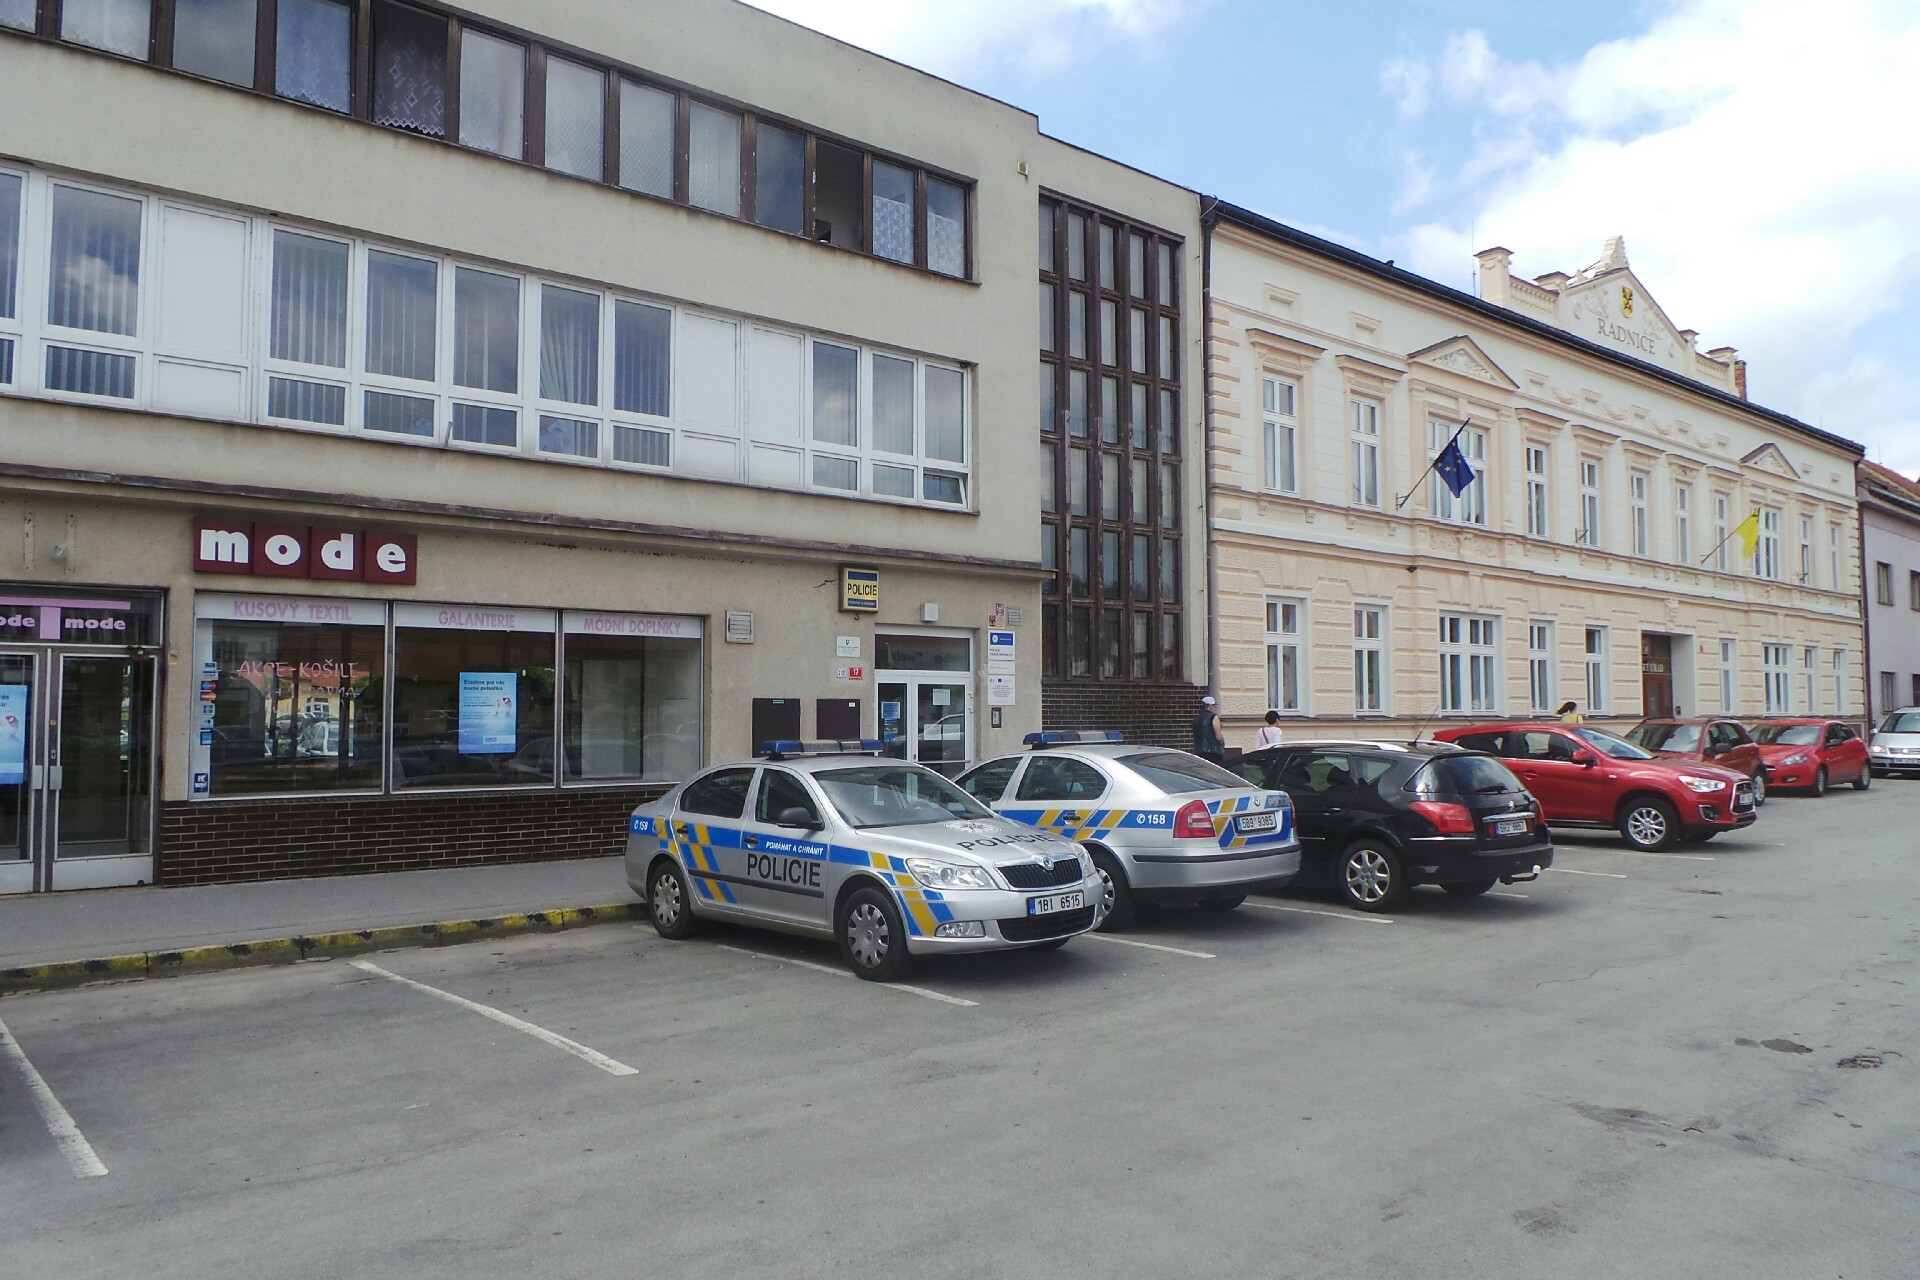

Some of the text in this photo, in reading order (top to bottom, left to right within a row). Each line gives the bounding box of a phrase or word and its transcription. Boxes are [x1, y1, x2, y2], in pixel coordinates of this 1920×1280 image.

[1597, 317, 1656, 355] RADNICE
[200, 528, 407, 573] mode
[847, 582, 878, 596] POLICIE
[233, 600, 352, 621] KUSOVÝ TEXTIL
[438, 610, 515, 628] GALANTERIE
[64, 617, 126, 630] mode
[583, 615, 681, 635] MÓDNÍ DOPLŇKY
[853, 668, 859, 676] 17
[639, 820, 649, 831] 158
[1147, 813, 1166, 825] 158
[765, 841, 824, 855] POMÁHAT A CHRÁNIT
[956, 834, 1055, 851] POLICIE
[746, 853, 821, 887] POLICIE
[1037, 894, 1080, 912] 1BI 6515
